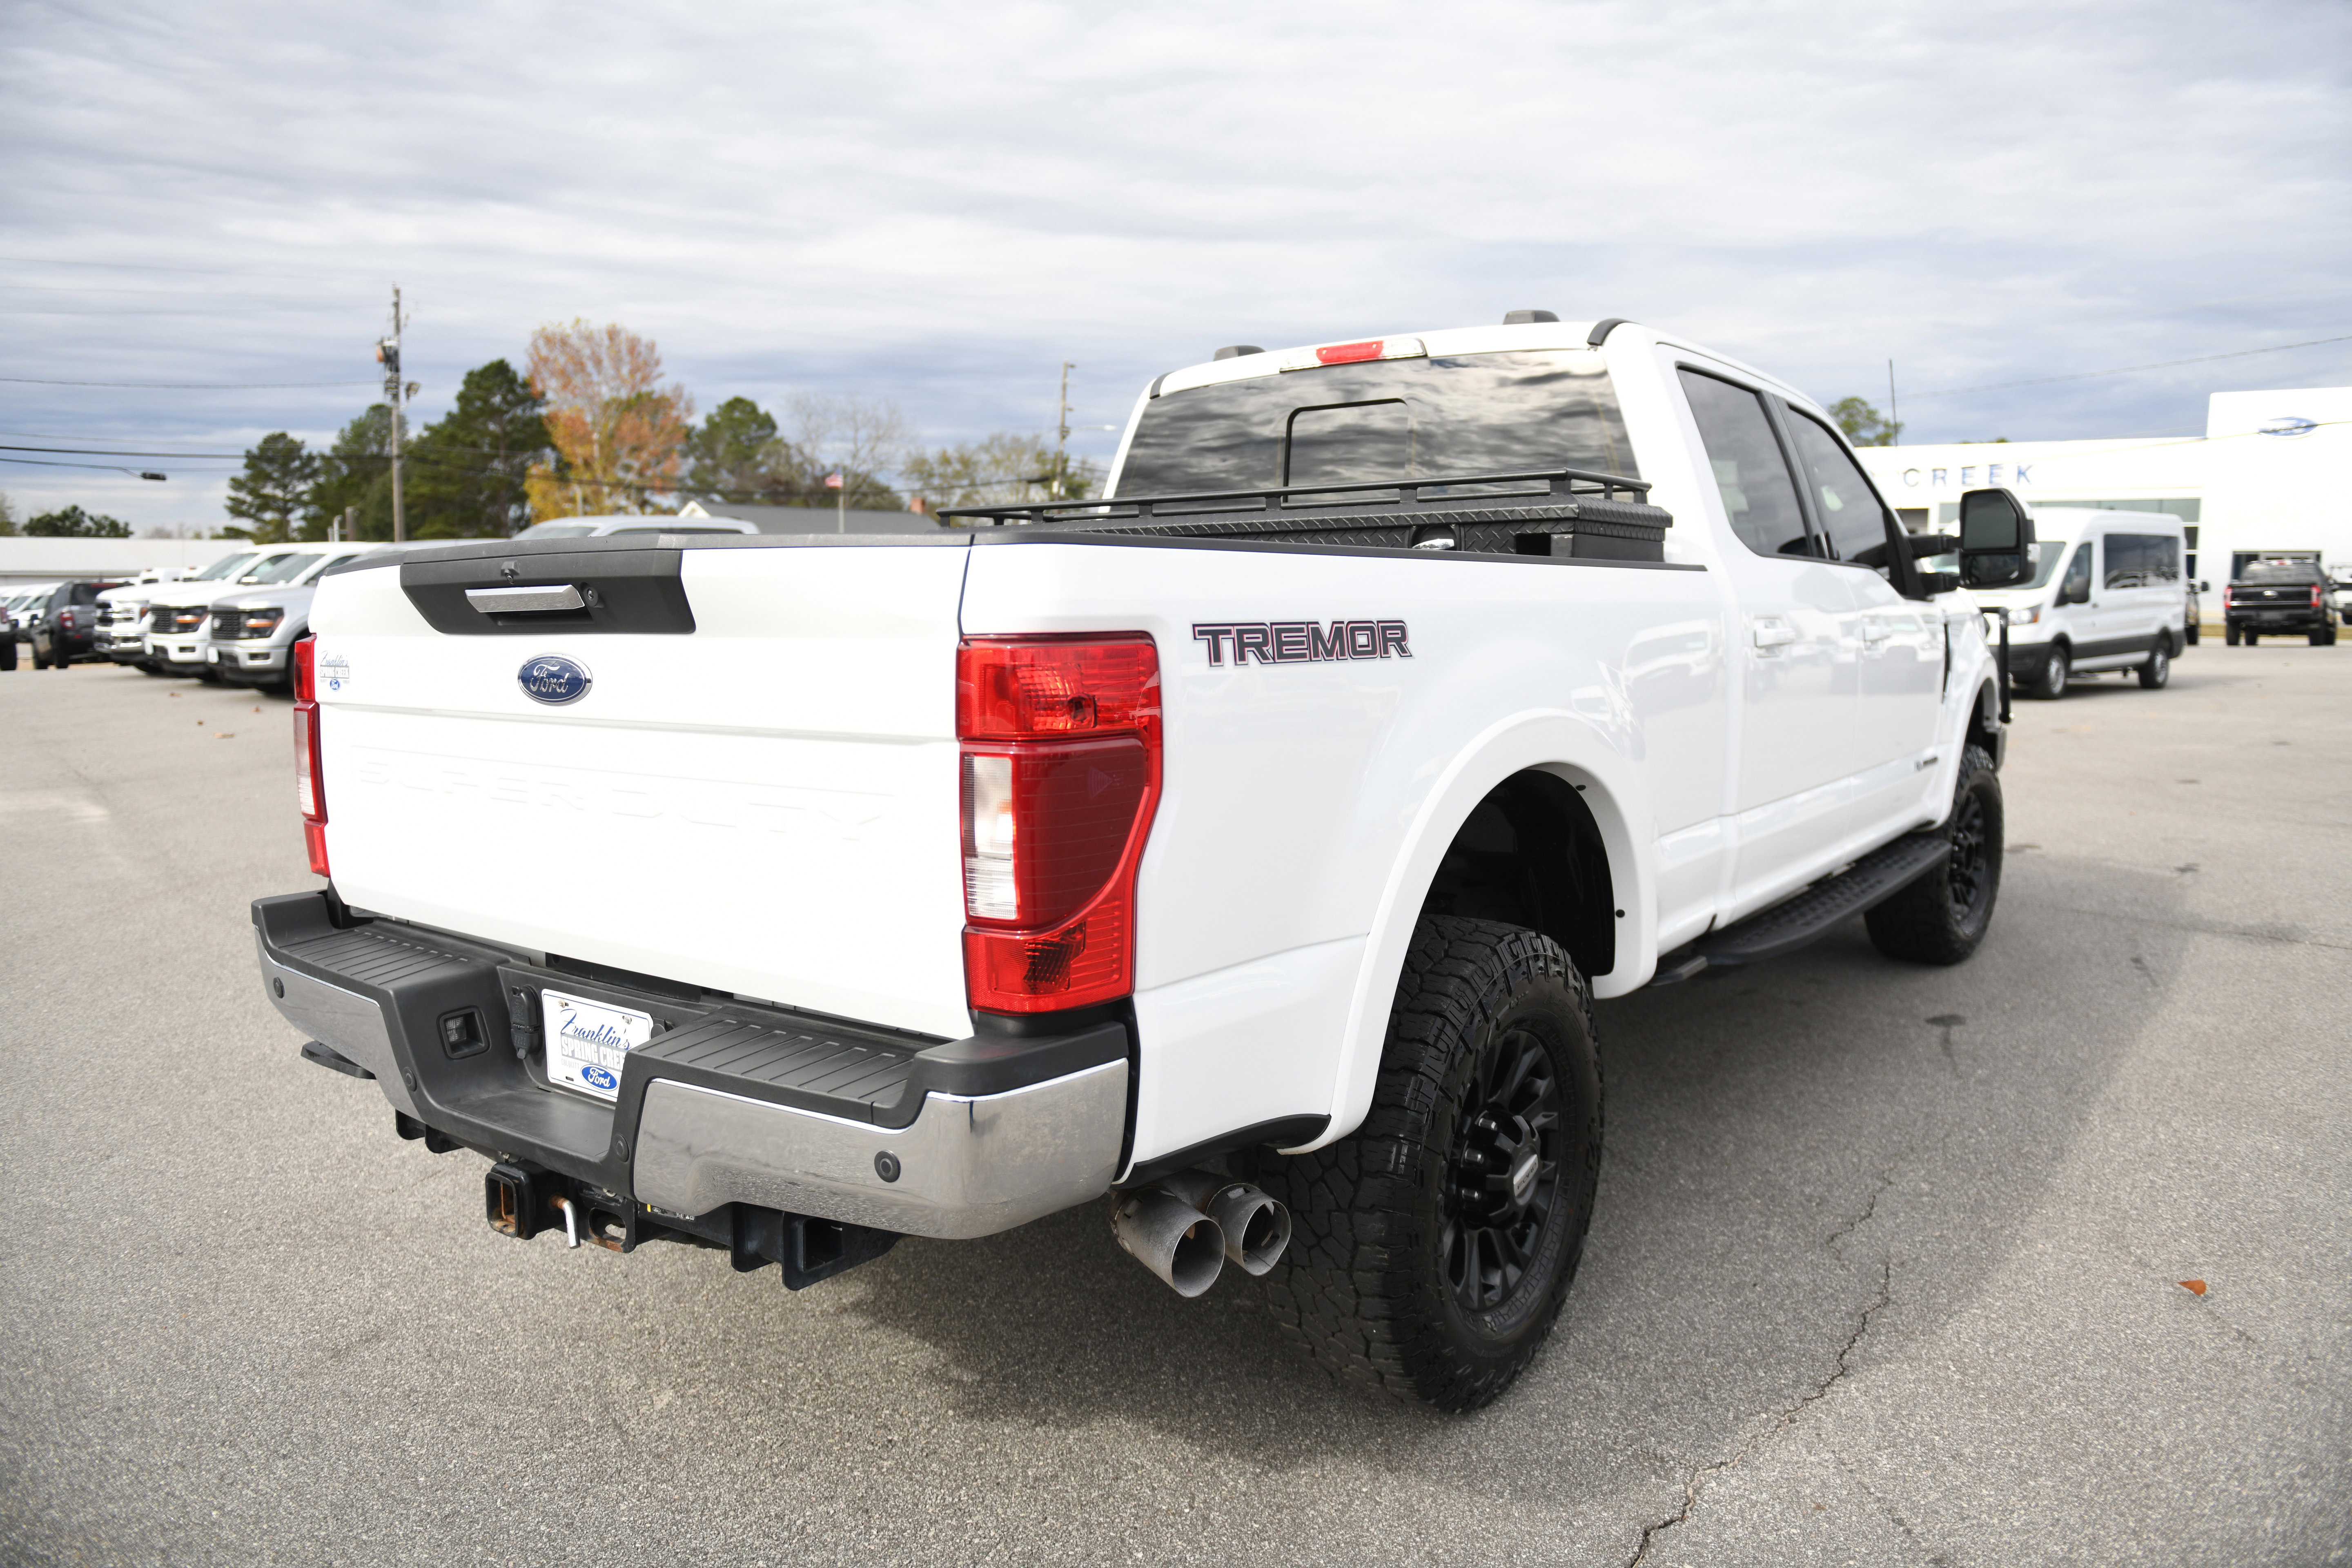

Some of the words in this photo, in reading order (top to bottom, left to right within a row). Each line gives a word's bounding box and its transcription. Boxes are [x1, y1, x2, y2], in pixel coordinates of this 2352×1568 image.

[1903, 464, 2033, 487] CREEK
[321, 650, 348, 666] Franklin's
[1190, 619, 1414, 670] TREMOR
[530, 664, 570, 693] Ford
[359, 758, 585, 810] SUPER
[612, 785, 882, 841] DUTY
[560, 1009, 632, 1051] Franklin's
[561, 1036, 599, 1064] SPRING
[599, 1046, 626, 1071] CREE
[561, 1058, 579, 1070] COLQUITT
[588, 1067, 611, 1088] Ford
[1517, 1162, 1537, 1190] FORD
